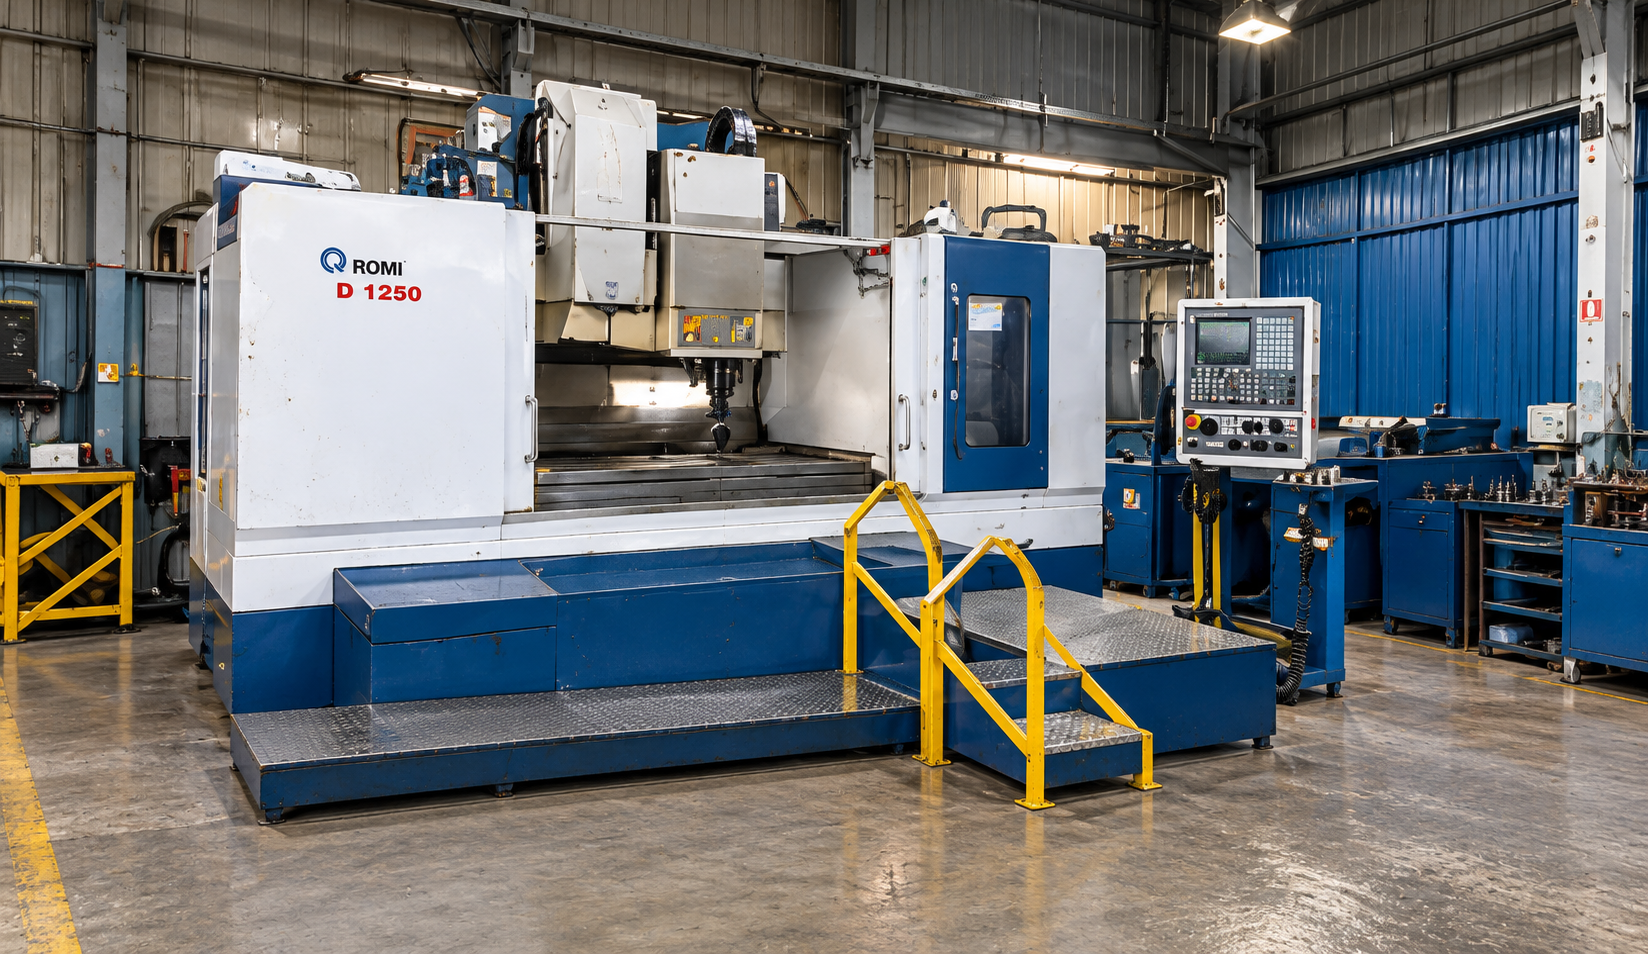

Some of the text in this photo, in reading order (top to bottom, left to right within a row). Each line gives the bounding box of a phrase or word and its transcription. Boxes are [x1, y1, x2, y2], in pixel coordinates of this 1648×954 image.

[353, 259, 402, 276] ROMI
[337, 282, 422, 302] D 1250
